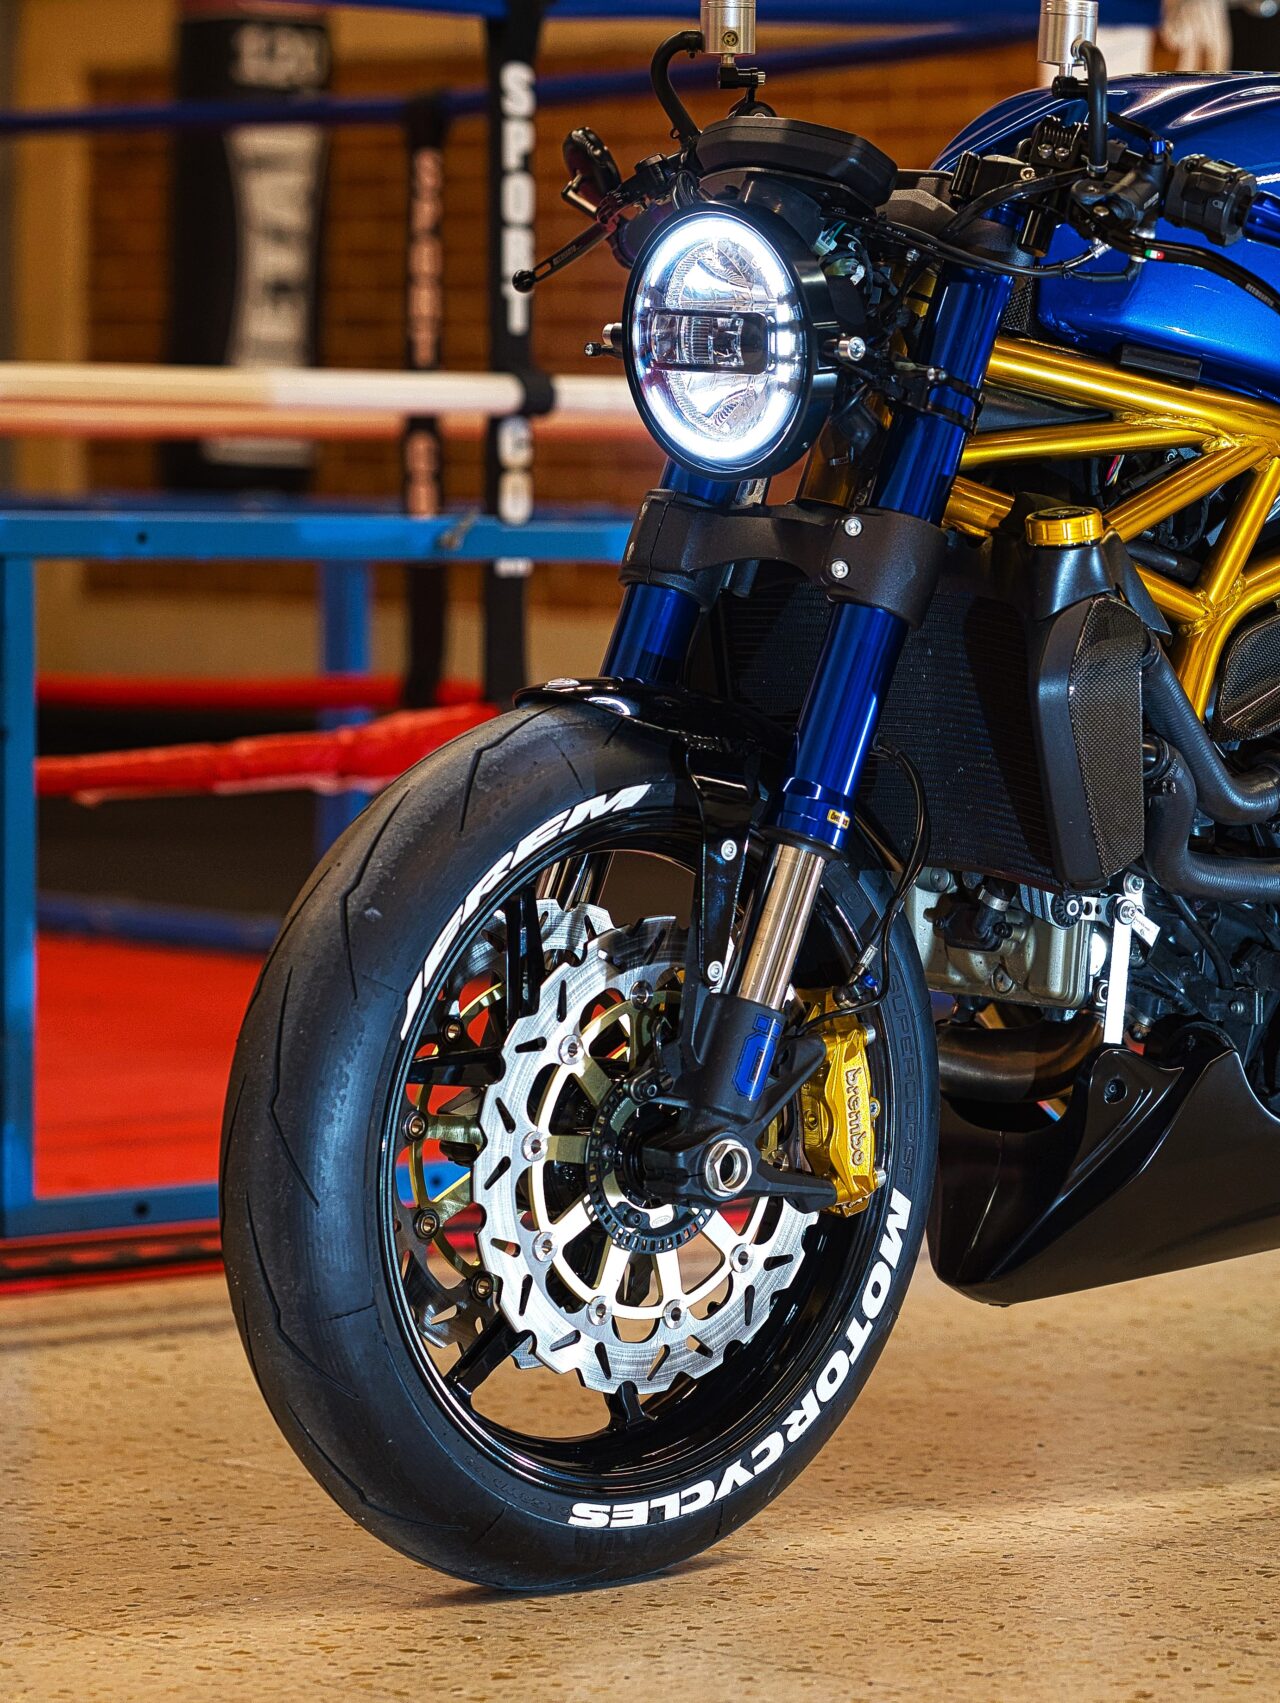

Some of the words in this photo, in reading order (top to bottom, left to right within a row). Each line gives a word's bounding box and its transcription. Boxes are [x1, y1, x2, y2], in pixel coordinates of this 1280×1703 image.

[400, 783, 652, 1042] JEREM
[844, 1066, 867, 1167] brembo
[567, 1187, 913, 1530] MOTORCYCLES
